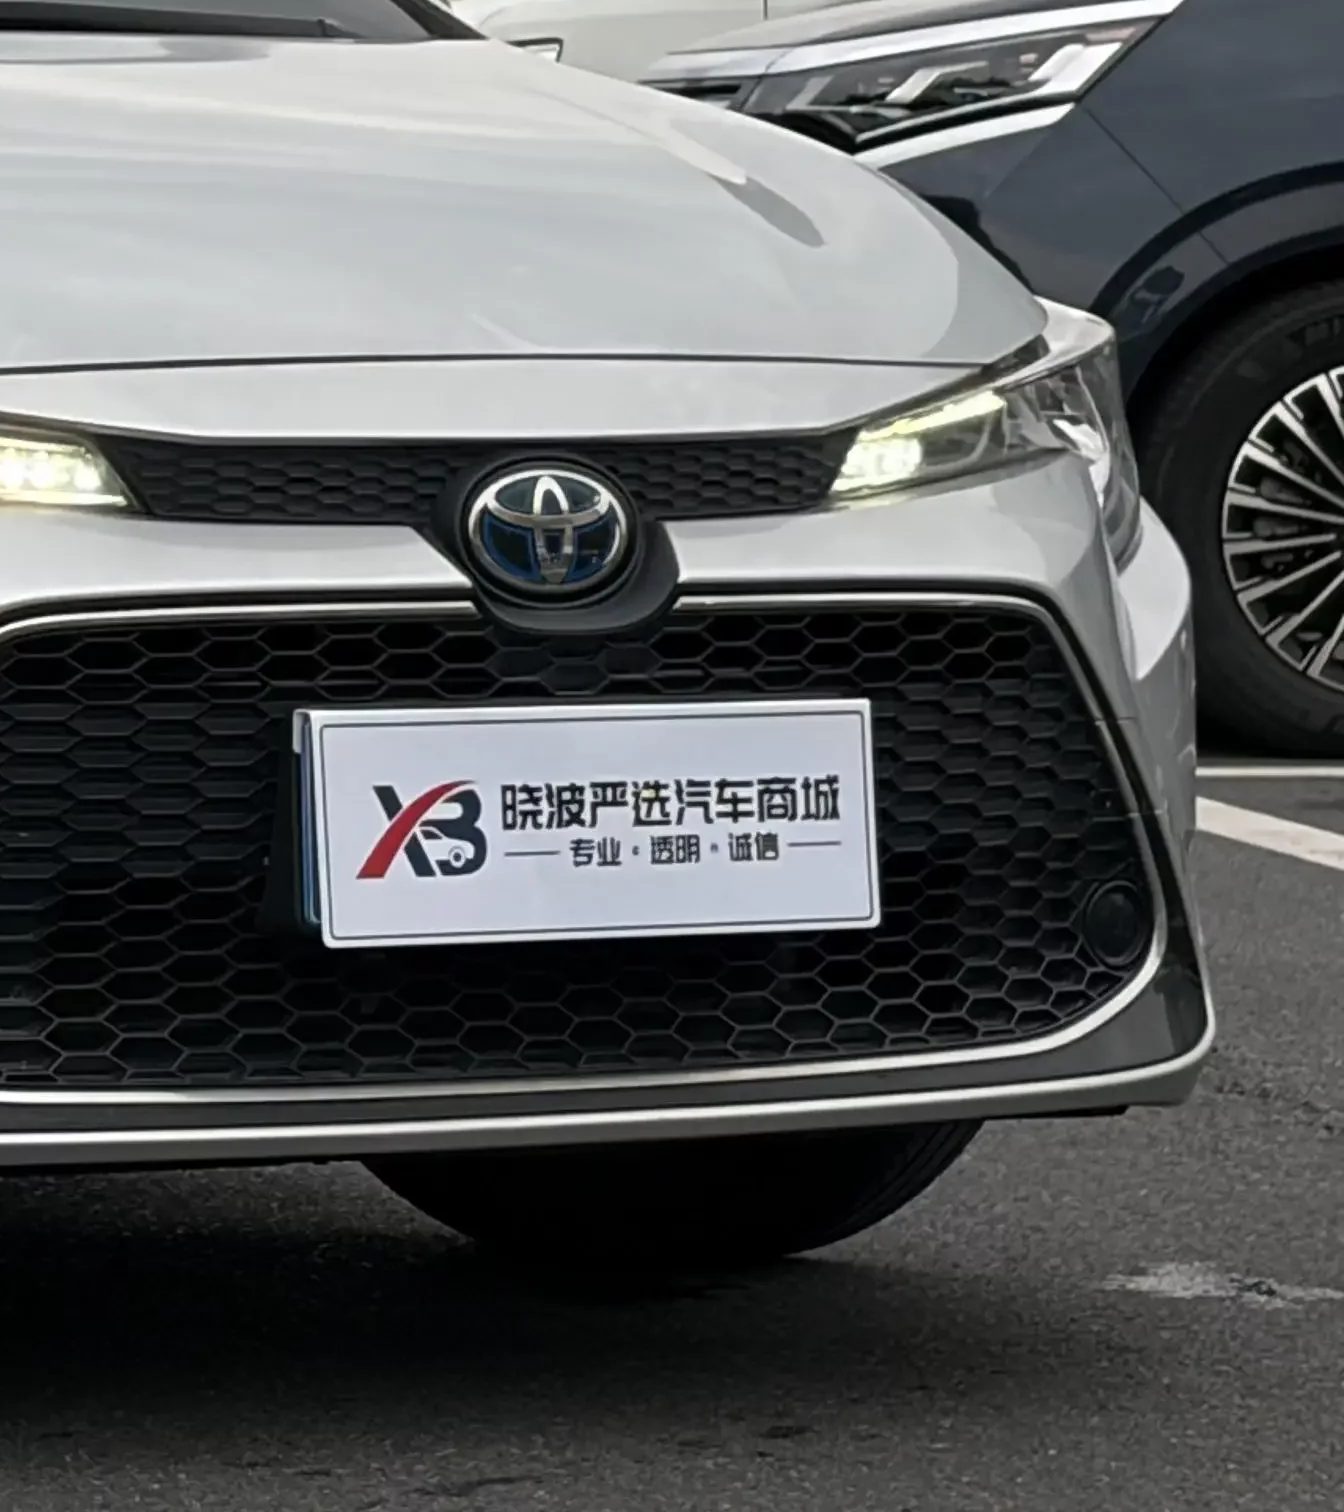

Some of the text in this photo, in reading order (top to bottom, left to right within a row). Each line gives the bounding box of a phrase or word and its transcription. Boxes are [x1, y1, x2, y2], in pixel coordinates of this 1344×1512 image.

[501, 774, 841, 830] 晓波严选汽车商城
